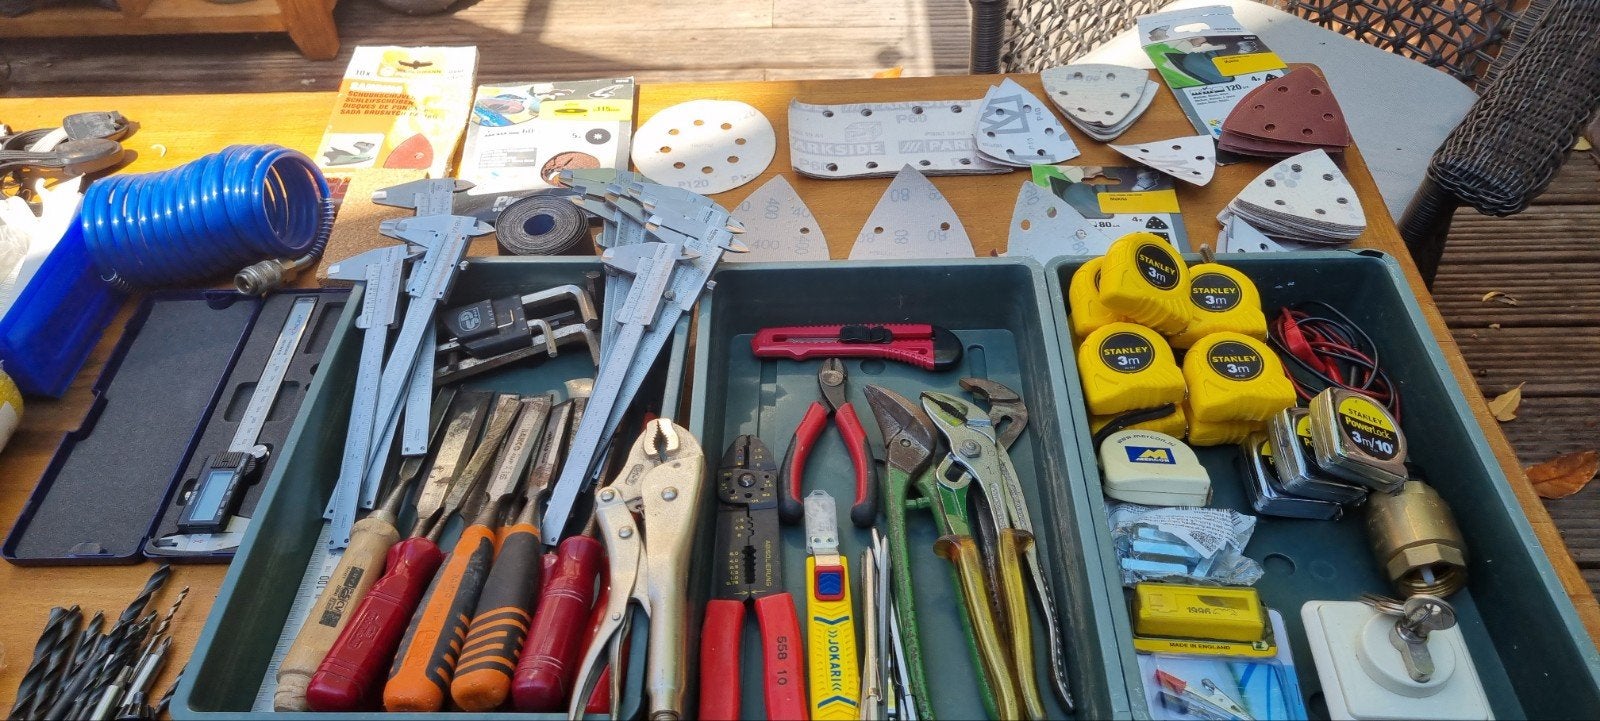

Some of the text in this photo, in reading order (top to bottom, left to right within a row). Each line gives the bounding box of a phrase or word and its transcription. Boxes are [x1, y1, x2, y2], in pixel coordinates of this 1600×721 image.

[678, 179, 710, 188] P120
[1139, 254, 1176, 276] STANLEY
[1148, 266, 1166, 282] 3m
[1205, 296, 1228, 304] 3m
[1104, 346, 1148, 356] STANLEY
[1117, 356, 1140, 366] 3m
[1212, 355, 1257, 364] STANLEY
[1226, 363, 1250, 374] 3m
[1348, 408, 1383, 426] STANLEY
[828, 638, 842, 682] JOKARI
